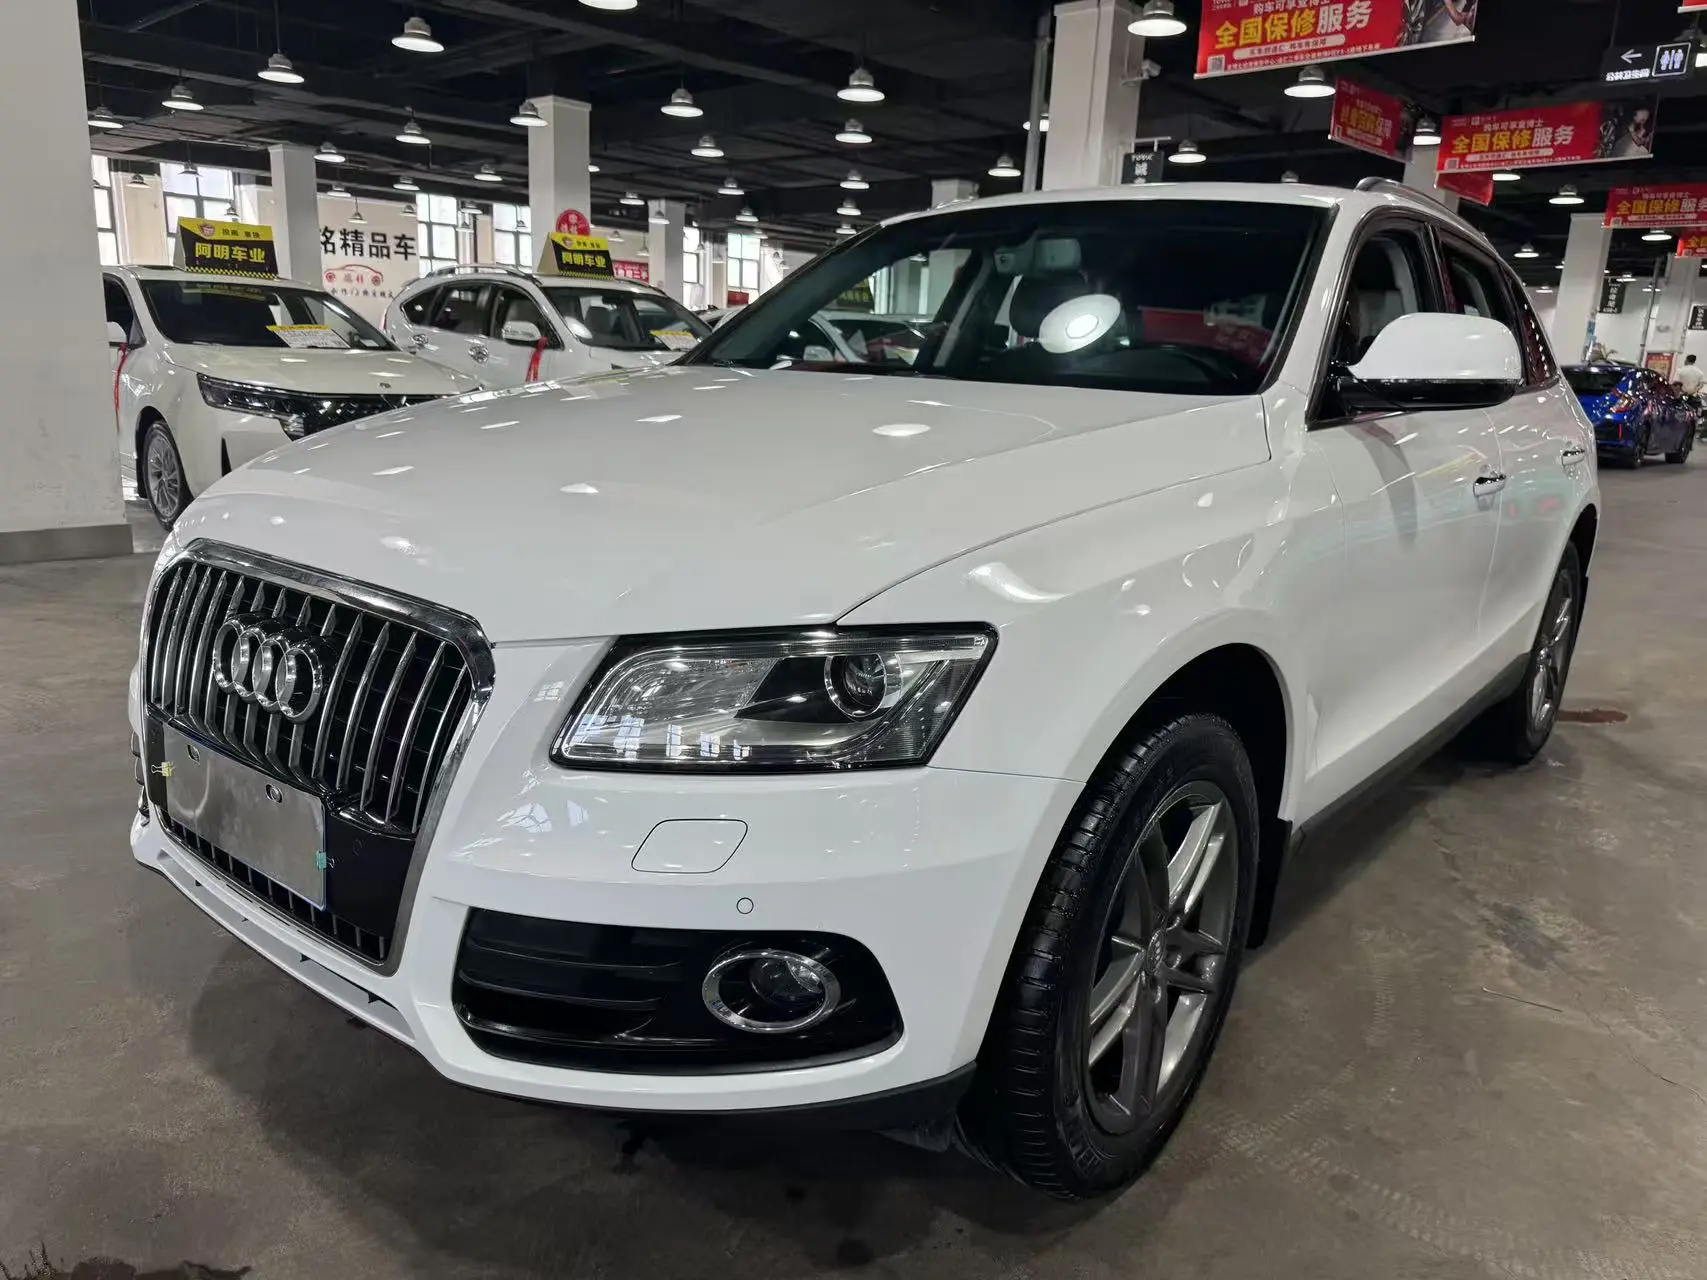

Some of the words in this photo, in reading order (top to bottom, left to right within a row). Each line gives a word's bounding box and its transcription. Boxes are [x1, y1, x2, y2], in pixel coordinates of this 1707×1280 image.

[1215, 0, 1372, 49] 全国保修服务
[1452, 125, 1574, 154] 全国保修服务
[195, 242, 266, 263] 阿明车业
[562, 251, 606, 268] 阿明车业
